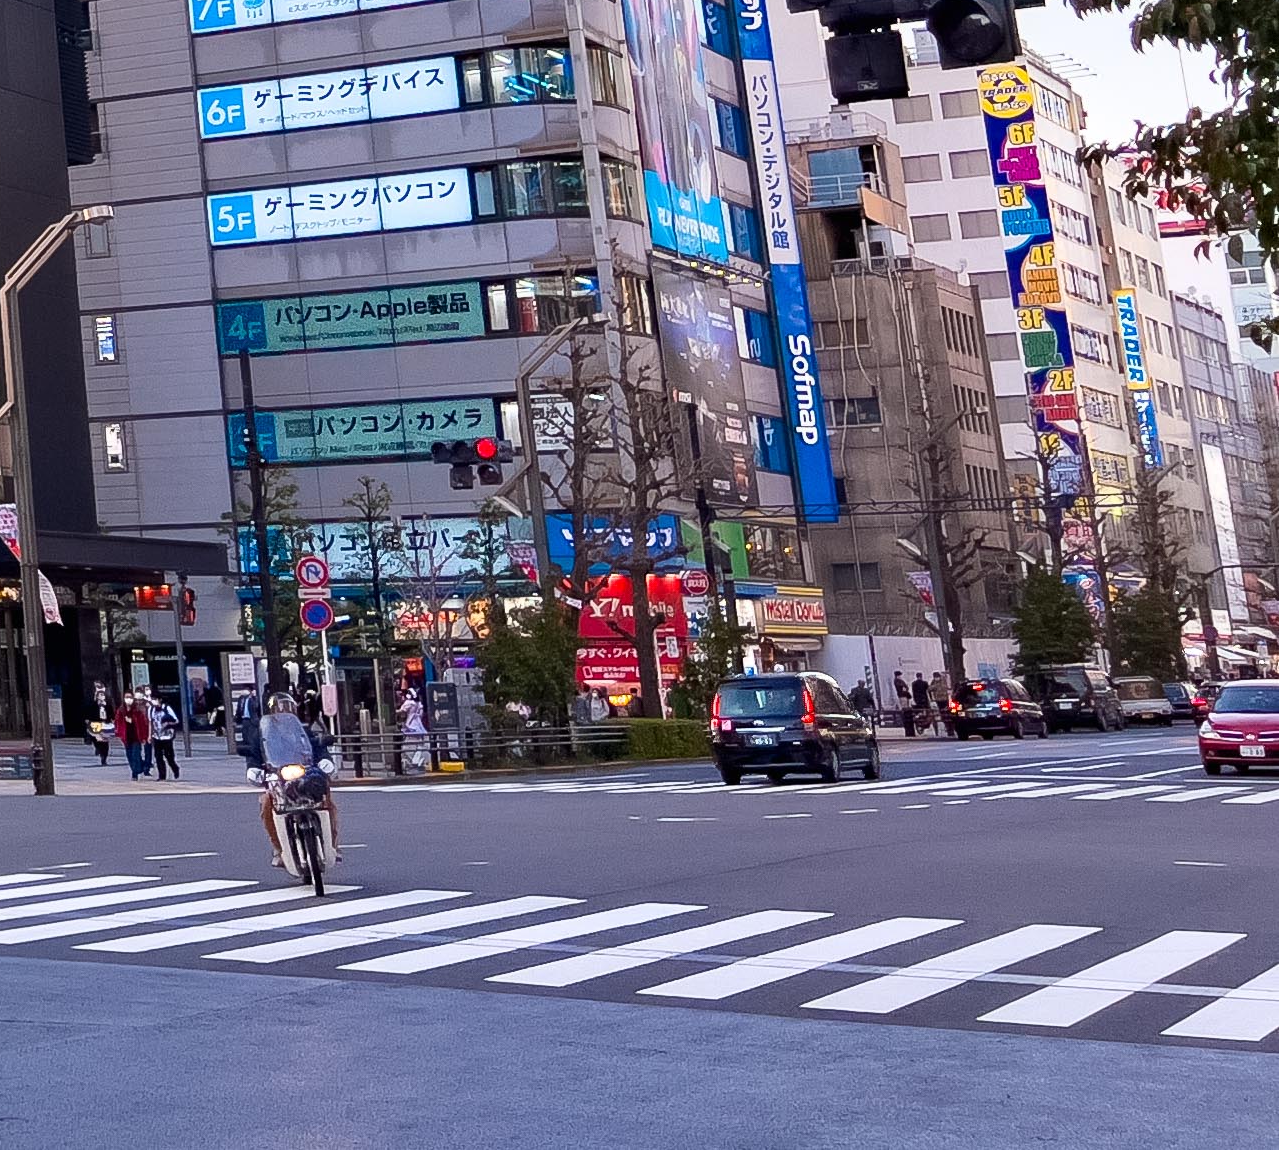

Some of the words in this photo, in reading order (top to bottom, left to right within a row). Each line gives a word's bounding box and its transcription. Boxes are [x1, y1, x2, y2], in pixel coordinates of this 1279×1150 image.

[253, 67, 444, 109] ゲーミングデバイス
[206, 99, 241, 126] 6F
[1008, 122, 1034, 145] 6F
[750, 74, 791, 250] パソコン・デジタル館
[264, 181, 457, 217] ゲーミングパソコン
[998, 185, 1025, 207] 5F
[217, 205, 253, 234] 5F
[1029, 244, 1055, 267] 4F
[275, 292, 471, 326] パソコン・Apple製品
[1017, 308, 1045, 330] 3F
[228, 315, 262, 340] 4F
[1115, 295, 1145, 385] TRADER
[788, 334, 819, 446] Sofmap
[1048, 369, 1074, 392] 2F
